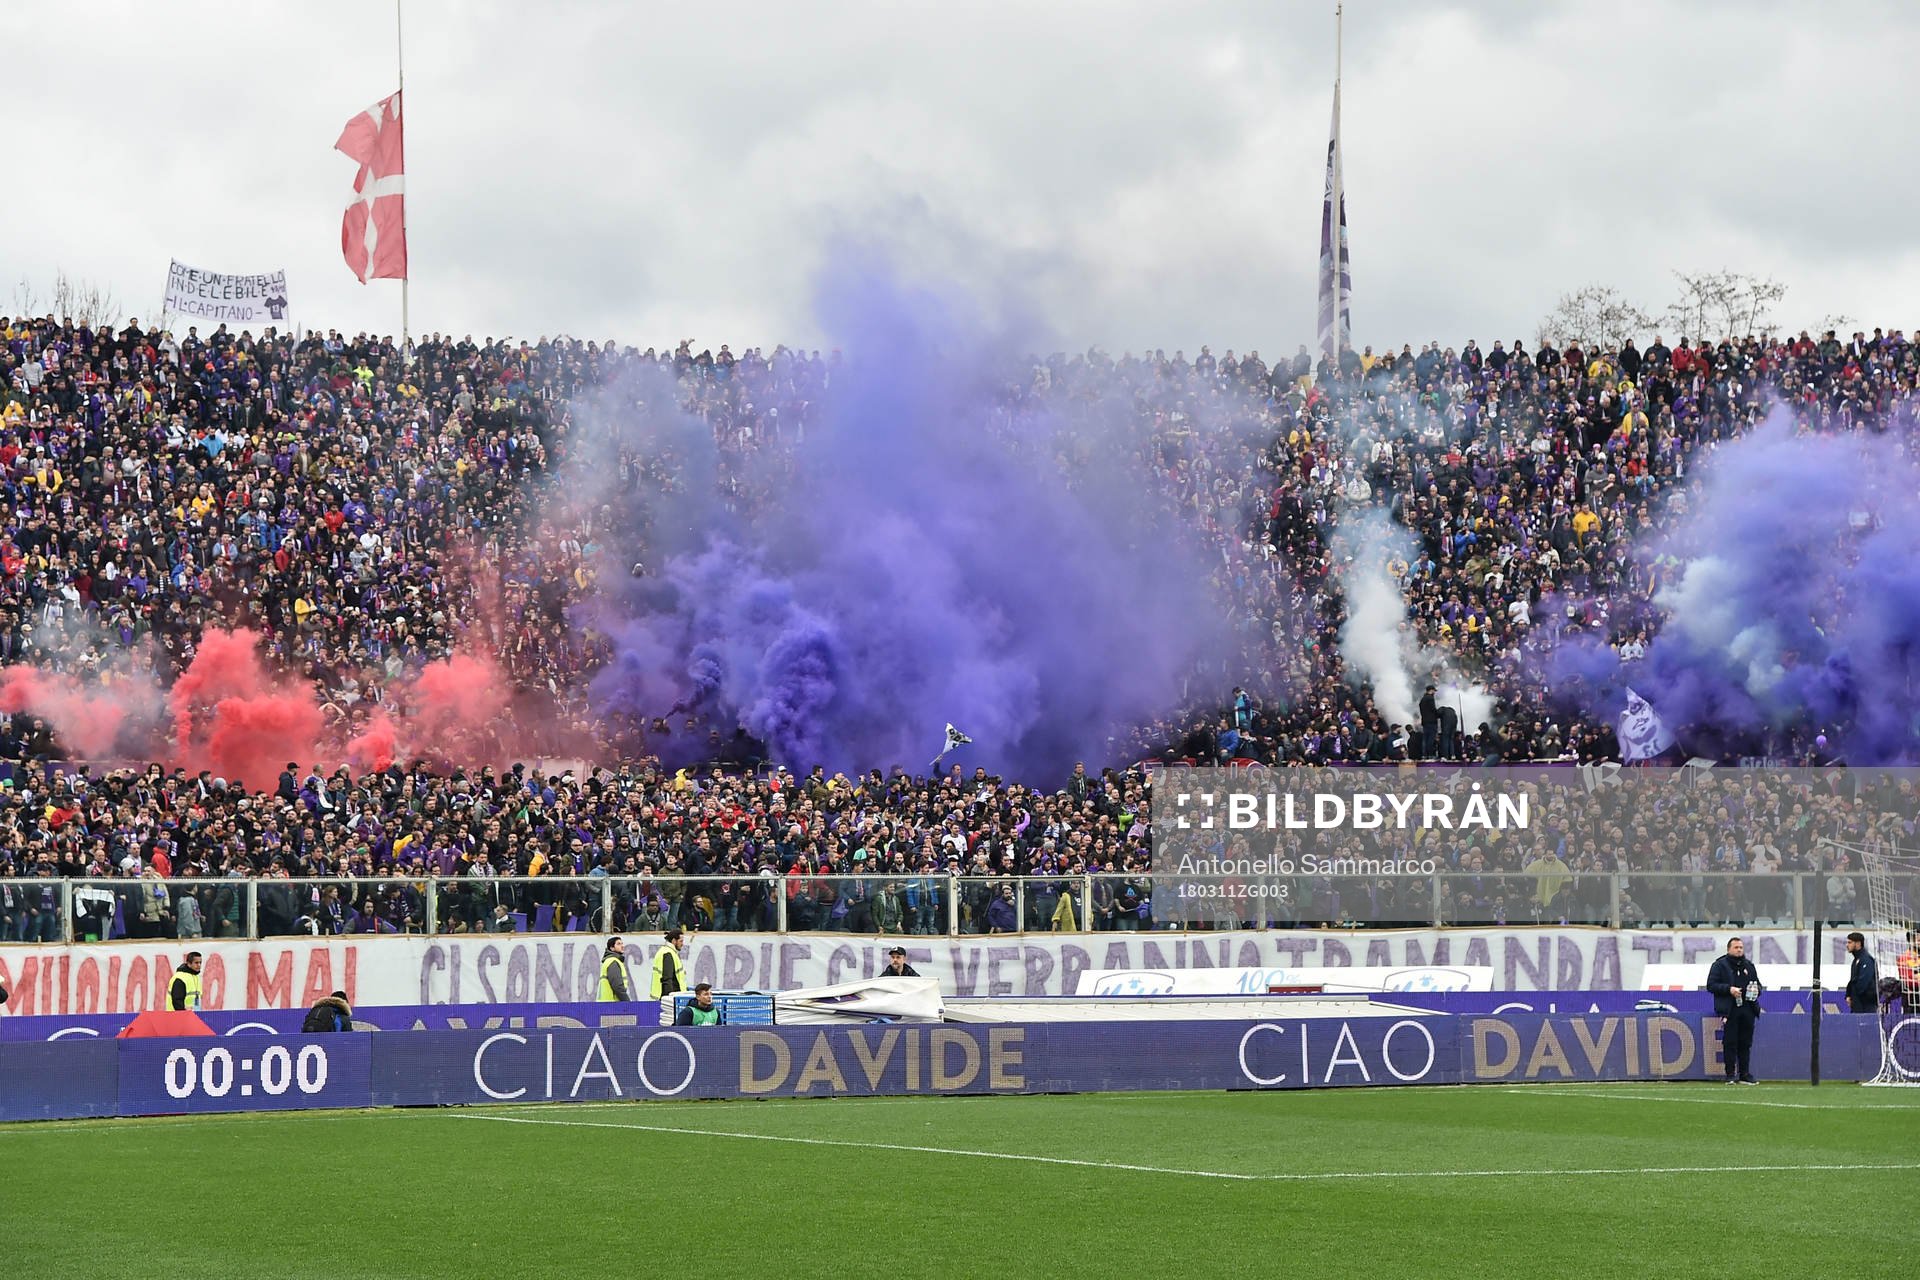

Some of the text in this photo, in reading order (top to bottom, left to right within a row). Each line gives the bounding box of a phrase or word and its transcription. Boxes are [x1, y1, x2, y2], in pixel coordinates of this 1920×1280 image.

[203, 272, 221, 285] UN
[227, 271, 286, 287] FRATELLO
[188, 301, 253, 320] CAPITANO
[247, 946, 357, 1009] MAI
[420, 944, 461, 1004] CI
[478, 943, 601, 1004] SONO
[164, 1045, 328, 1099] 00:00
[473, 1027, 1025, 1099] CIAO DAVIDE
[1238, 1016, 1726, 1085] CIAO DAVIDE
